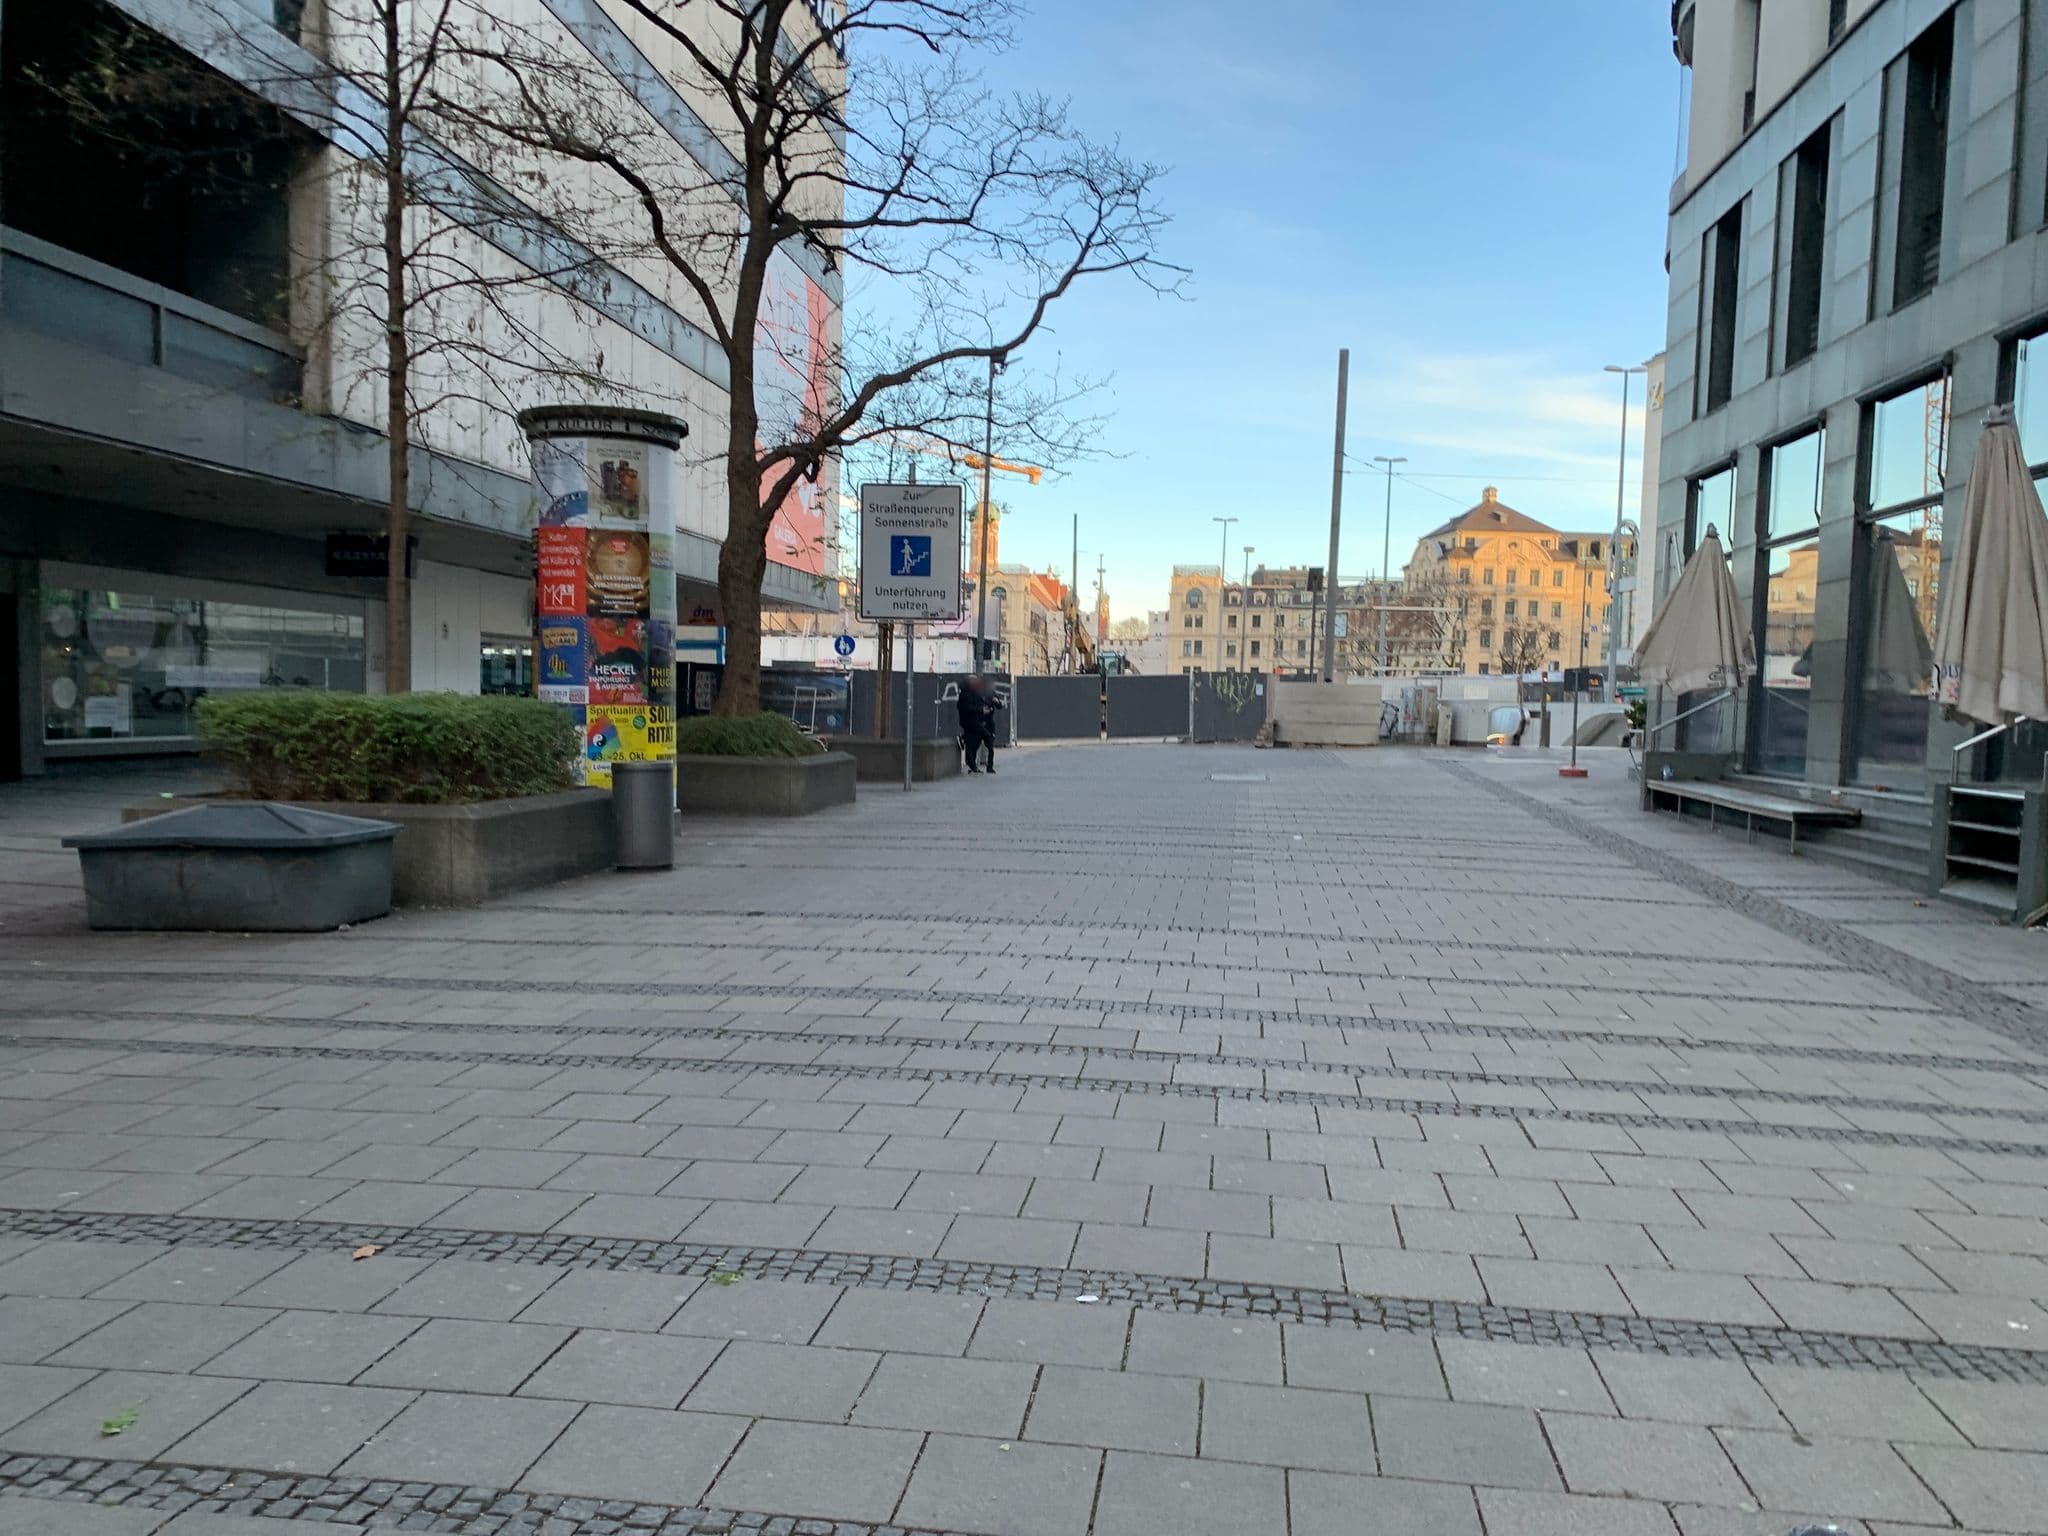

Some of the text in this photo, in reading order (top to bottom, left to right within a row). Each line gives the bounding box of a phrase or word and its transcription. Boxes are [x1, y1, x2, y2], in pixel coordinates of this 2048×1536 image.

[902, 490, 921, 501] Zur
[868, 503, 955, 516] Straßenquerung
[874, 517, 949, 529] Sonnenstraße
[875, 585, 946, 598] Unterführung
[693, 604, 714, 618] dm
[892, 600, 928, 611] nutzen
[595, 664, 637, 675] HECKEL
